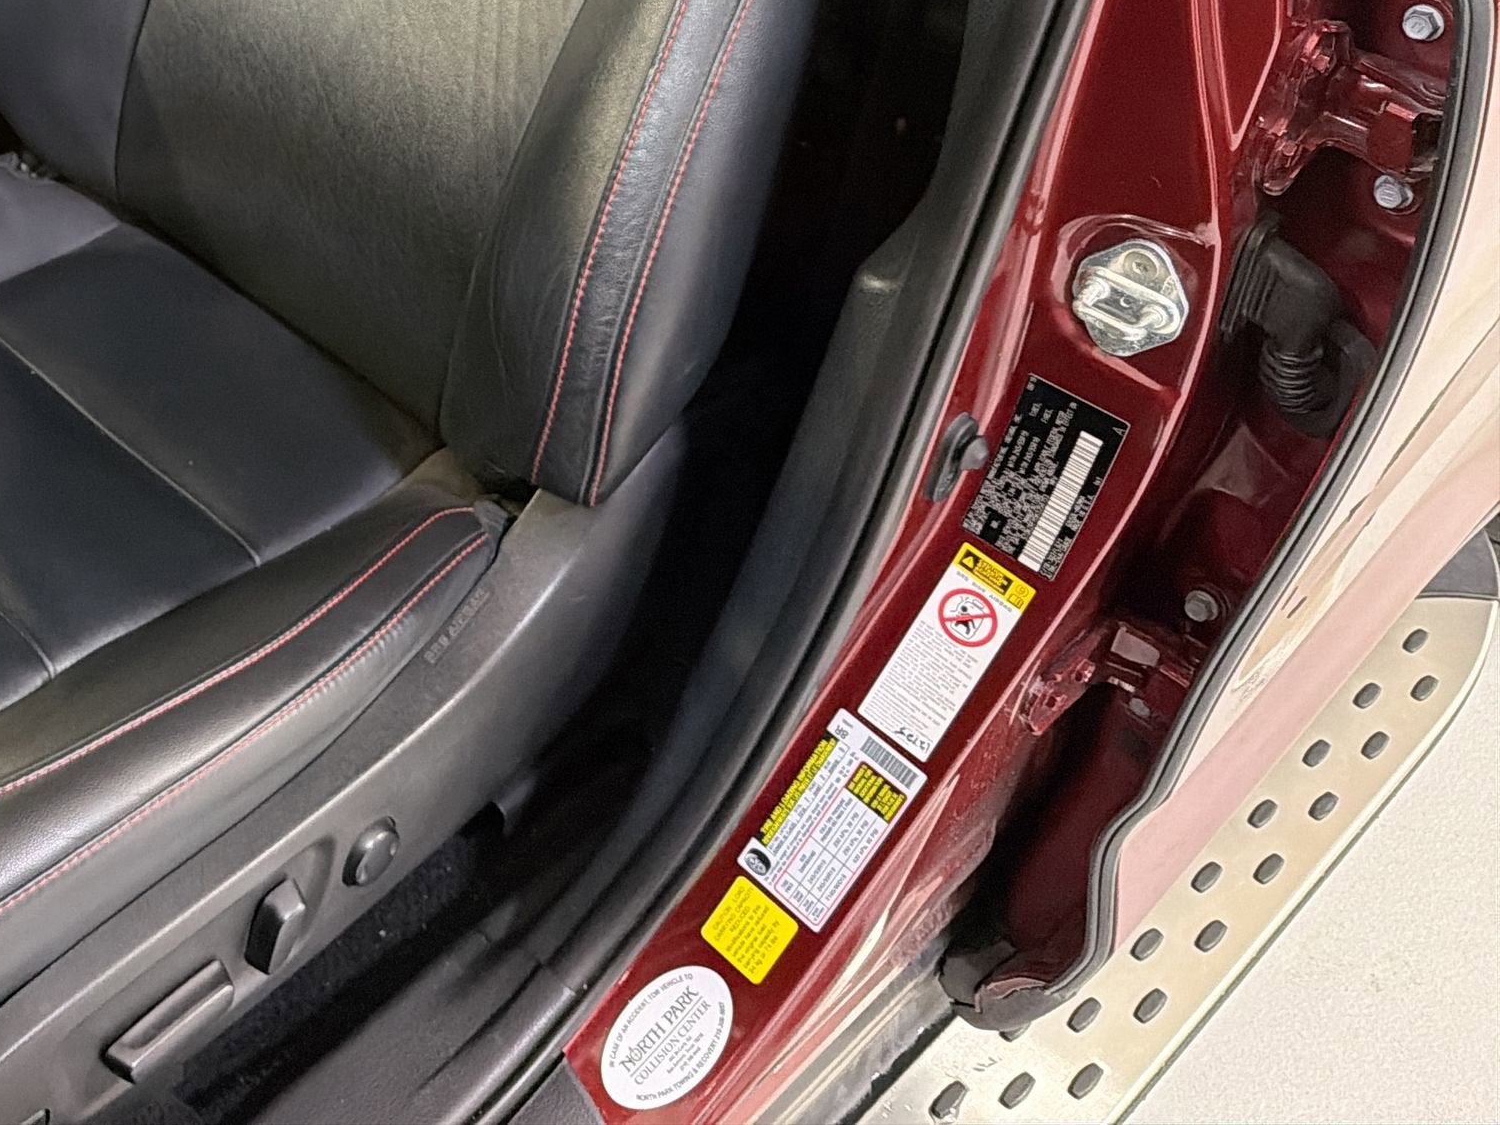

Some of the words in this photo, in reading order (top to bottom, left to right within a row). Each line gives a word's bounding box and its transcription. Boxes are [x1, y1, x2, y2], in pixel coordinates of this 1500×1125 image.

[618, 1021, 667, 1074] NORTH
[661, 984, 700, 1025] PARK
[634, 1034, 680, 1085] COLLISION
[677, 999, 712, 1038] CENTER
